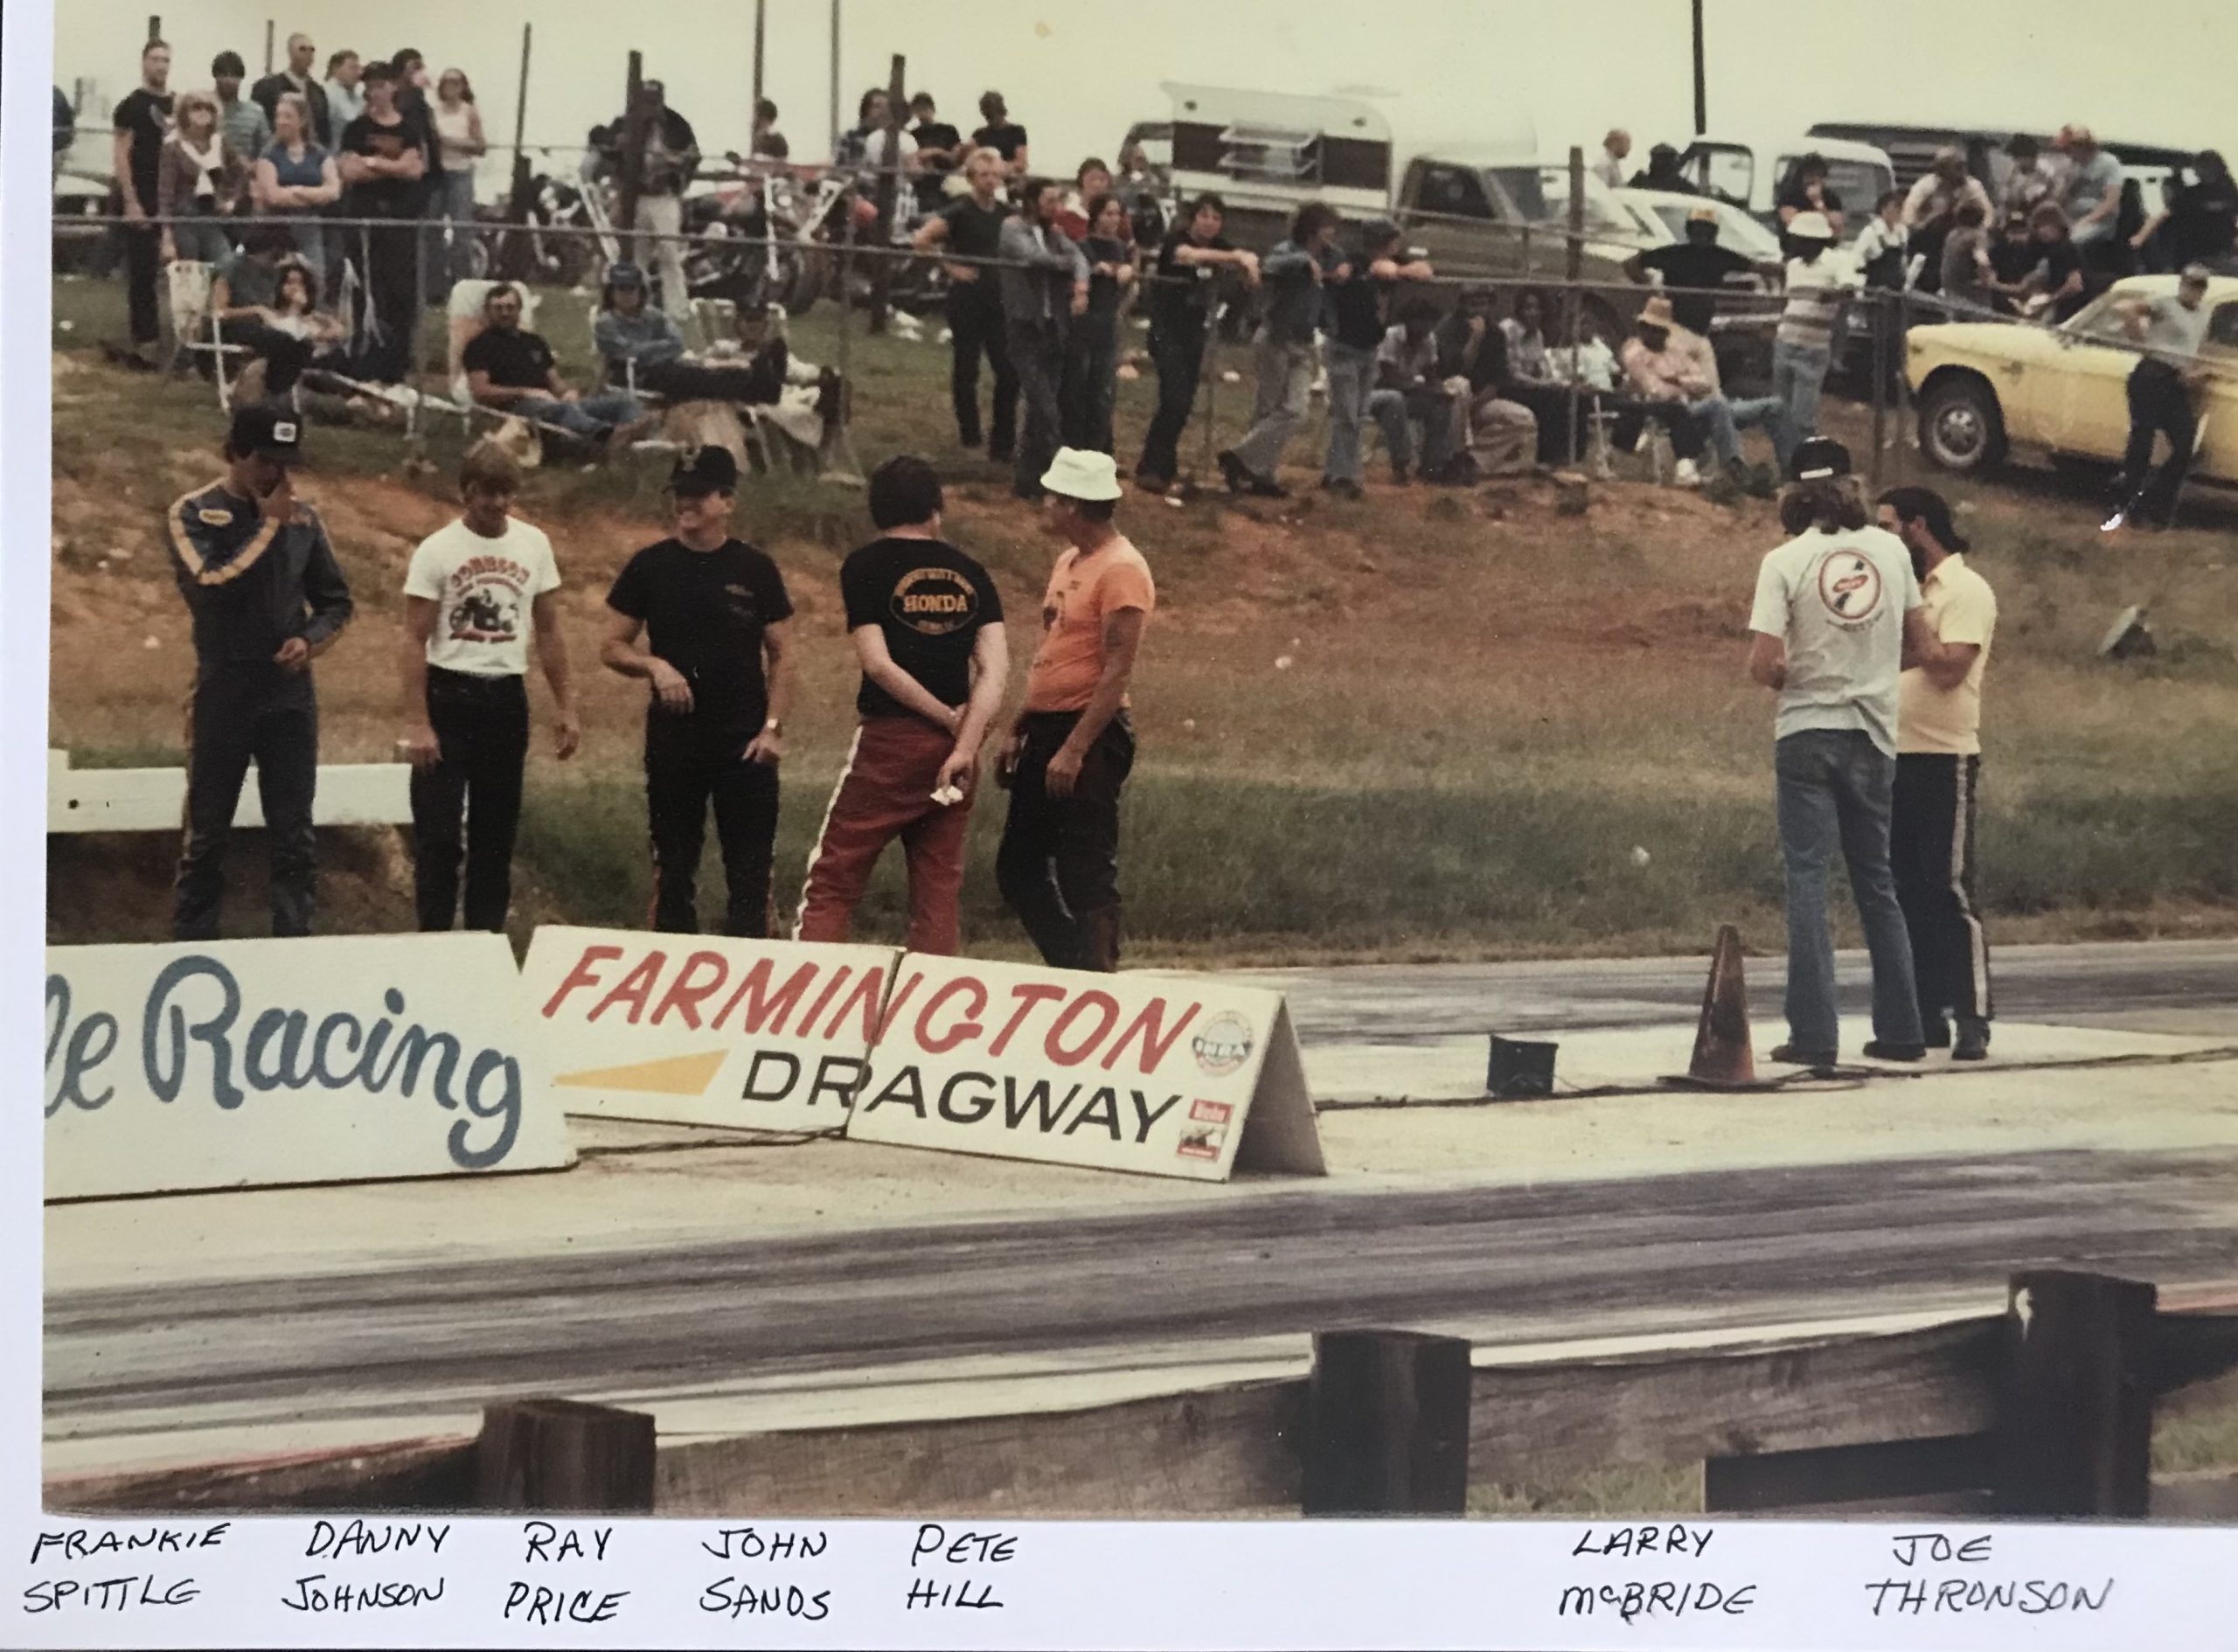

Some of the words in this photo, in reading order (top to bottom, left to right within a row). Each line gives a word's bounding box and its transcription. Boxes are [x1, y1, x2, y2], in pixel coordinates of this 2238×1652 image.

[902, 593, 969, 612] HONDA
[542, 945, 1201, 1074] FARMINGTON
[142, 954, 522, 1169] Racing
[742, 1050, 1182, 1145] DRAGWAY
[31, 1523, 231, 1564] FRANKIE
[305, 1520, 450, 1559] DANNY
[524, 1521, 612, 1563] RAY
[702, 1528, 826, 1561] JOHN
[912, 1524, 1018, 1566] PETE
[1573, 1524, 1713, 1557] LARRY
[1893, 1534, 1992, 1566] JOE
[24, 1574, 201, 1613] SPITTLE
[281, 1574, 444, 1612] JOHNSON
[504, 1580, 631, 1625] PRICE
[699, 1576, 831, 1621] SANDS
[907, 1578, 1004, 1609] HILL
[1865, 1578, 2114, 1616] THRONSON
